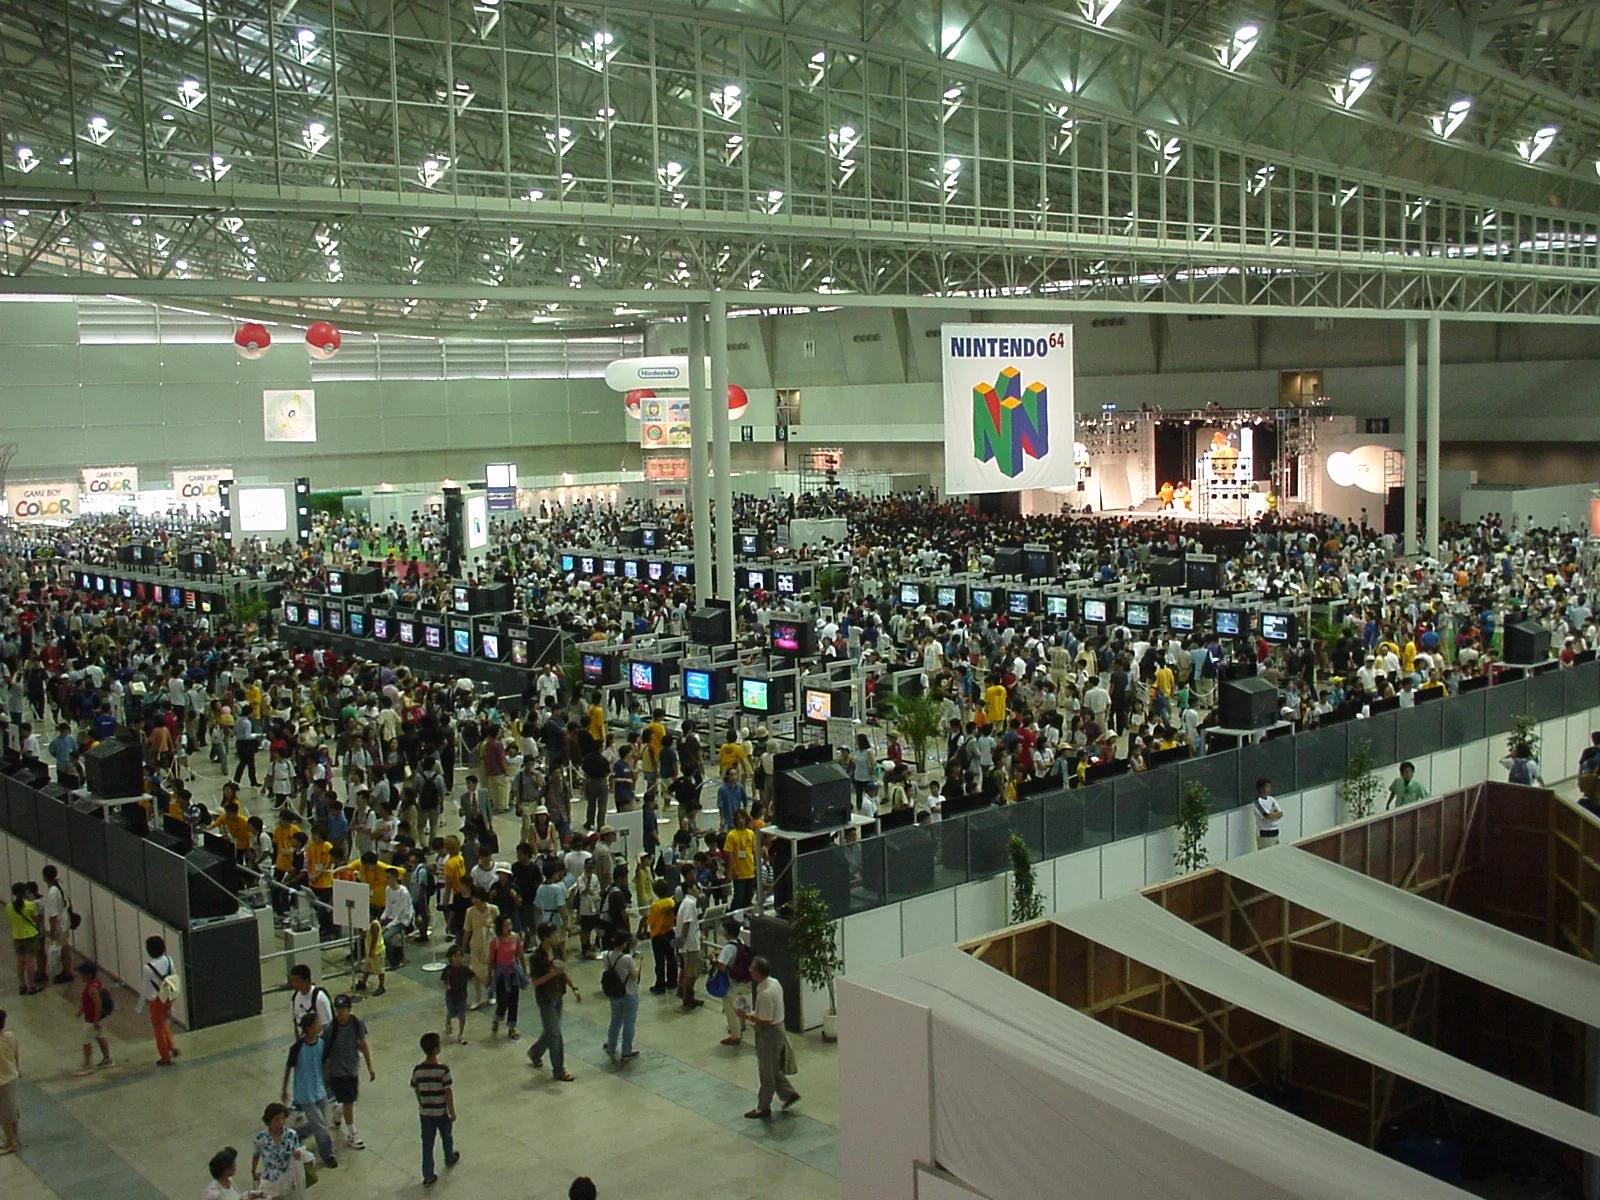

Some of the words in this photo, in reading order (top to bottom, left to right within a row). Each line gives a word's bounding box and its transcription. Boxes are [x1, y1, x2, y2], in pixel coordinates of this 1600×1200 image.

[951, 337, 1048, 357] NINTENDO
[1048, 332, 1065, 348] 64
[90, 479, 132, 492] COLOR
[182, 483, 219, 497] COLO
[24, 490, 45, 498] GAME
[15, 499, 73, 517] COLOR
